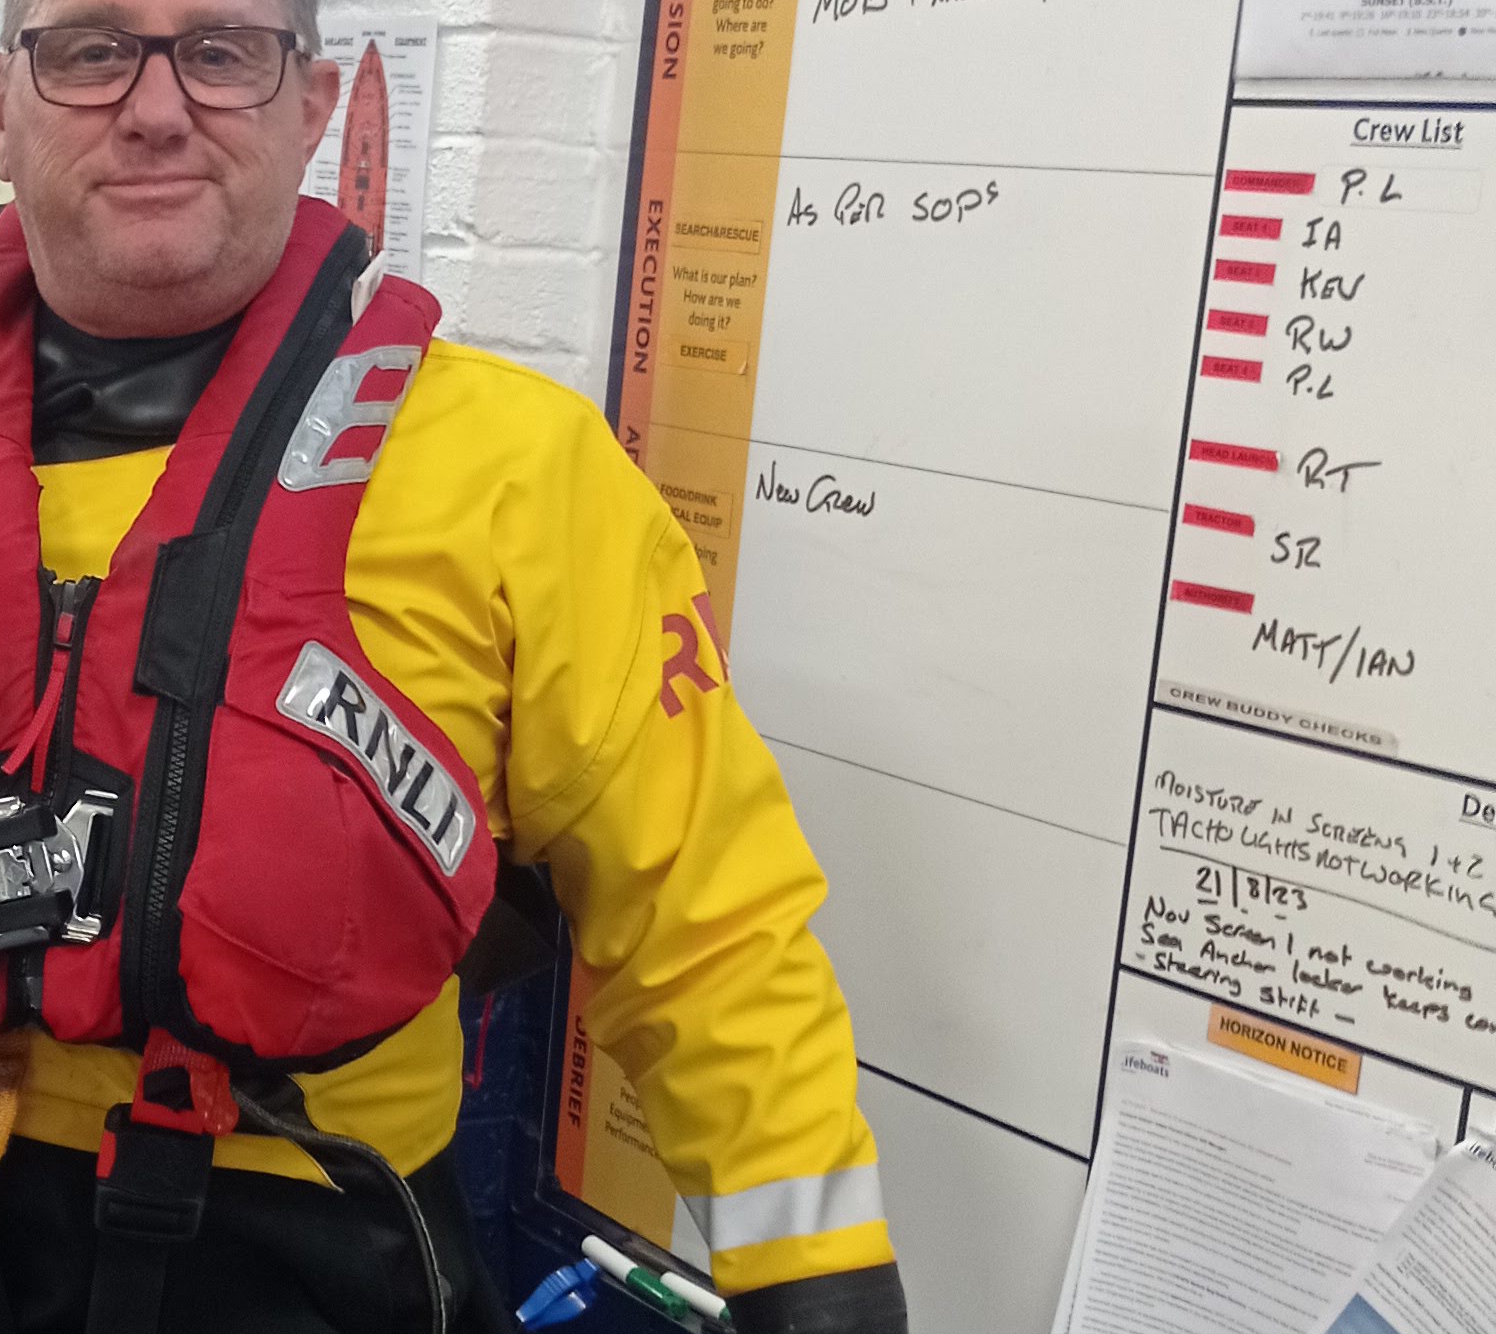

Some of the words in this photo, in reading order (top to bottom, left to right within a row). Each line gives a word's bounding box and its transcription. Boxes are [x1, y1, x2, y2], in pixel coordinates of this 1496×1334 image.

[716, 19, 749, 33] Where
[750, 21, 767, 33] are
[713, 43, 729, 55] we
[729, 40, 764, 60] going?
[1354, 117, 1416, 144] Crew
[1420, 118, 1464, 145] List
[675, 222, 760, 242] SEARCH&RESCUE
[633, 199, 664, 374] EXECUTION
[673, 266, 699, 282] What
[700, 270, 710, 283] is
[711, 272, 727, 285] our
[729, 273, 758, 289] plan?
[1300, 266, 1365, 301] KEV
[683, 290, 706, 305] How
[707, 294, 724, 307] are
[726, 297, 741, 309] we
[688, 314, 716, 332] doing
[716, 316, 731, 330] it?
[1285, 314, 1352, 355] RW
[680, 345, 727, 362] EXERCISE
[755, 460, 800, 504] New
[693, 512, 723, 529] EQUIP
[1195, 511, 1242, 529] TRACTOR
[1270, 531, 1322, 569] SR
[1170, 686, 1222, 708] CREW
[1226, 700, 1293, 725] BUDDY
[1298, 719, 1383, 747] CHECKS
[314, 668, 464, 845] RNLI
[1155, 770, 1263, 815] MOISTURE
[1149, 807, 1233, 842] TACHO
[1140, 923, 1183, 952] Sea
[1200, 940, 1276, 975] Anchor
[1292, 959, 1364, 995] locker
[1383, 984, 1450, 1023] keeps
[1205, 913, 1276, 950] Screen
[1309, 944, 1352, 967] not
[1366, 956, 1473, 1002] working
[1219, 1015, 1286, 1050] HORIZON
[1290, 1041, 1349, 1073] NOTICE
[1121, 1054, 1169, 1078] ifeboats
